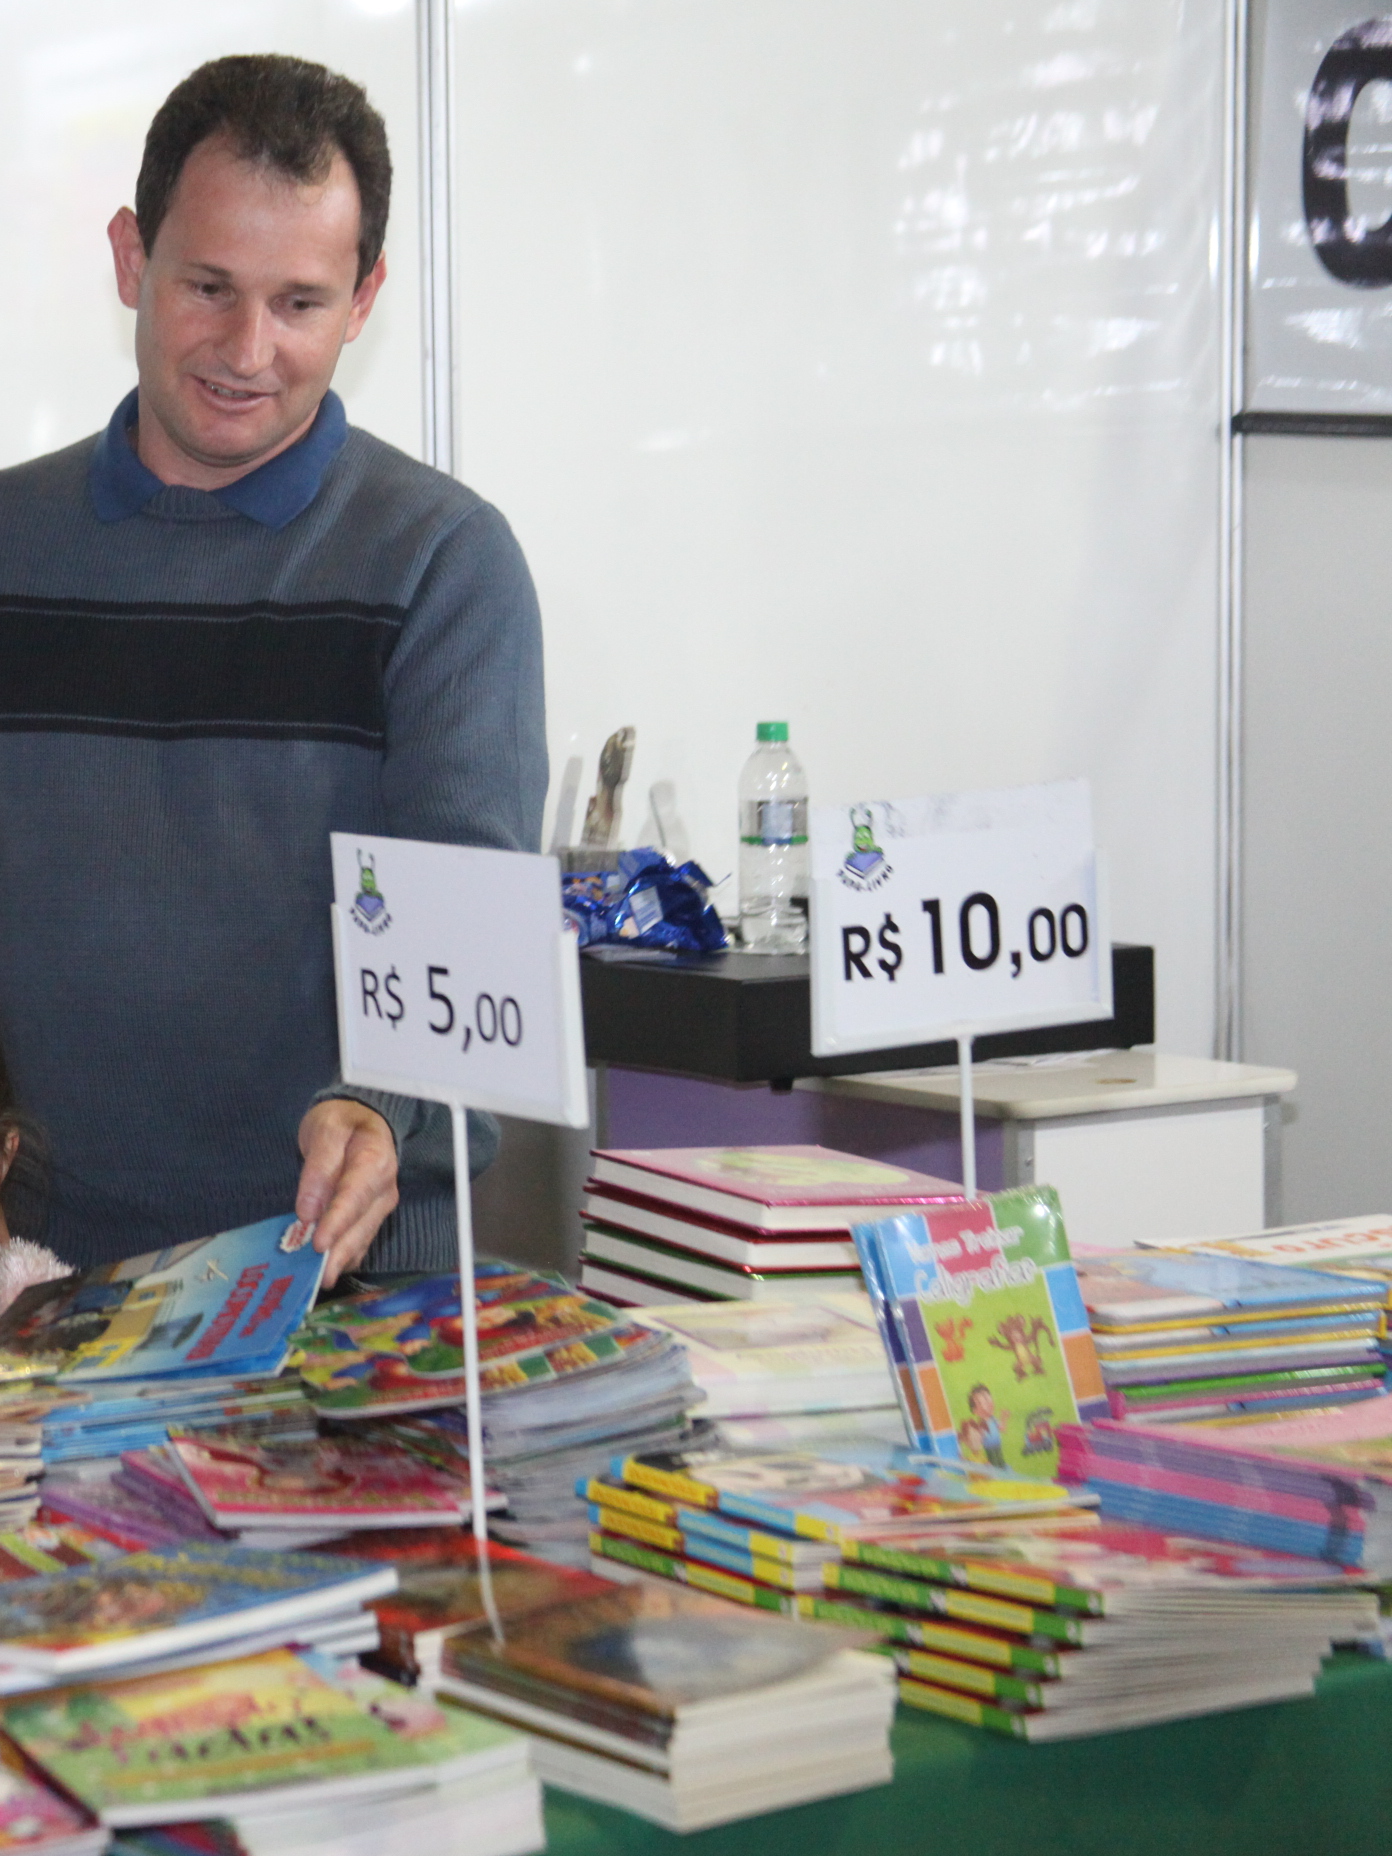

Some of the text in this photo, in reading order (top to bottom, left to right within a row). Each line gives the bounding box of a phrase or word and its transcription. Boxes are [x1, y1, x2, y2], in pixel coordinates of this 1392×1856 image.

[842, 891, 1088, 982] R$ 10,00
[360, 964, 522, 1053] R$ 5,00
